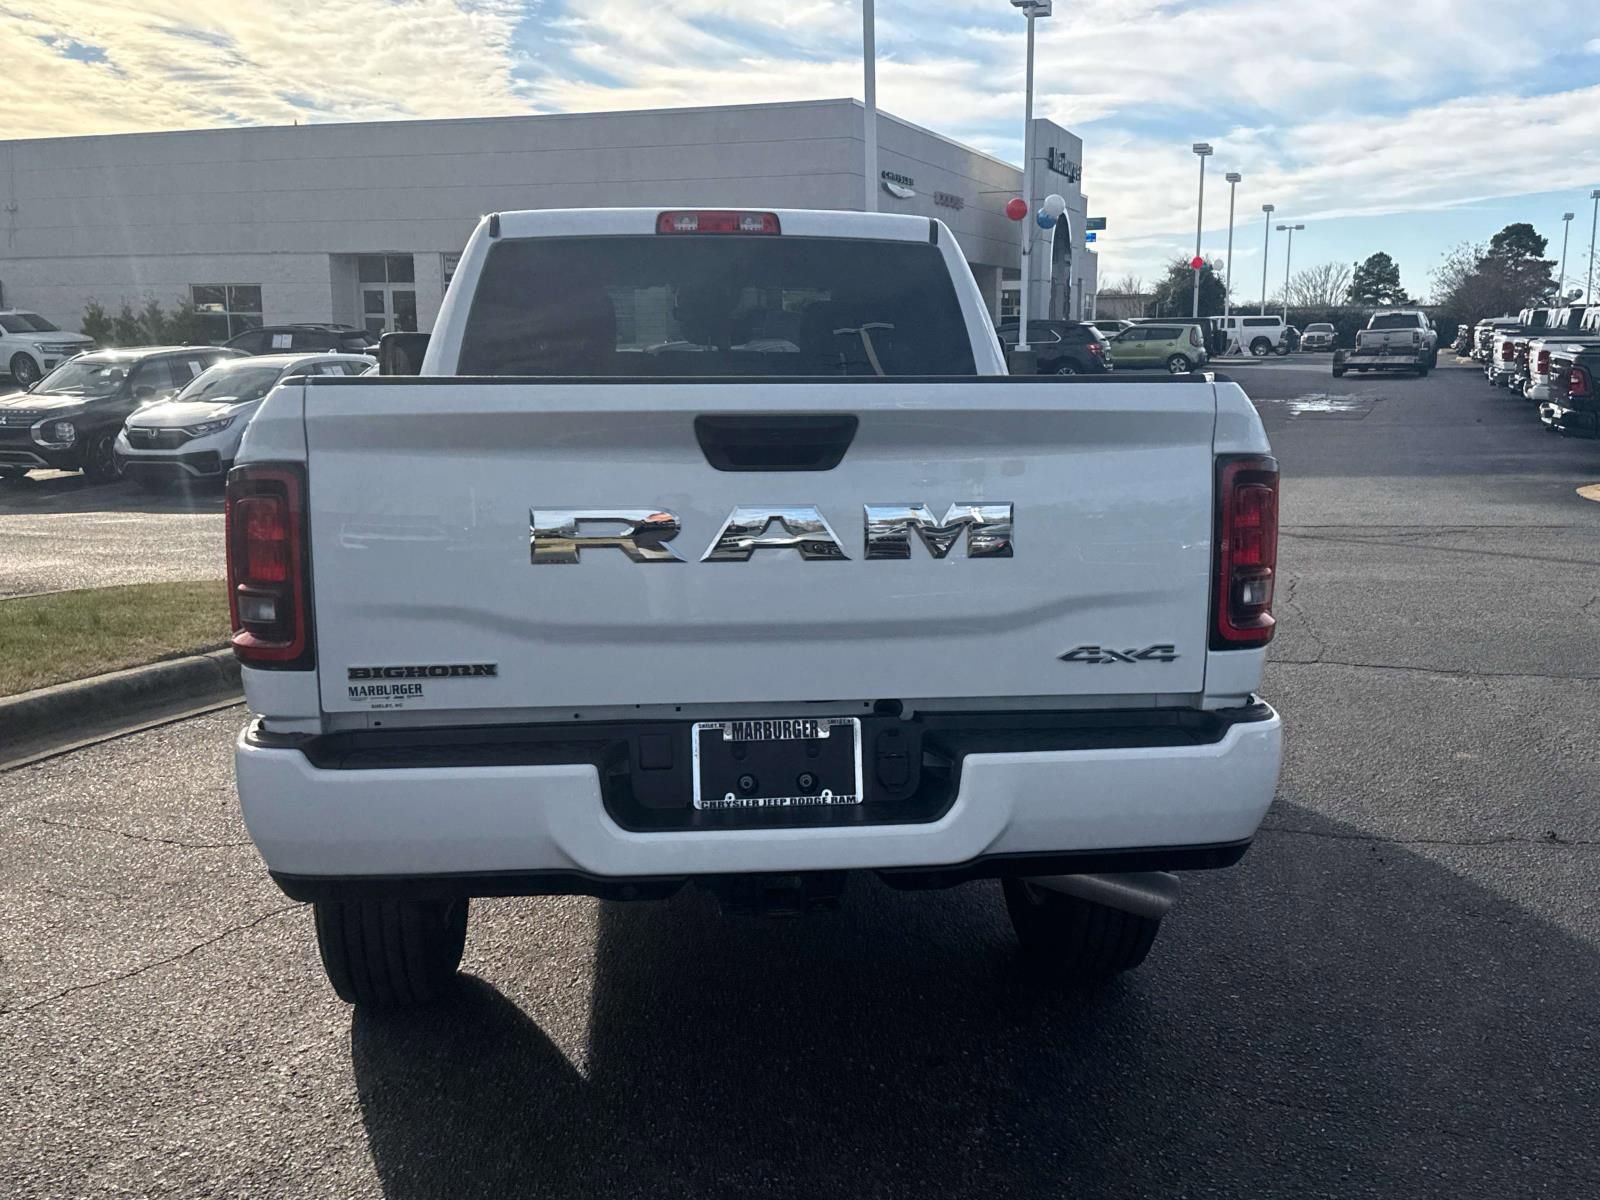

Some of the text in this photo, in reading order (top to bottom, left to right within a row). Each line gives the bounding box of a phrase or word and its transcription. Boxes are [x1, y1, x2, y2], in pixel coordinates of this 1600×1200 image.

[530, 501, 1014, 564] RAM
[348, 663, 497, 680] BIGHORN
[348, 683, 422, 697] MARBURGER
[732, 720, 819, 740] MARBURGER
[701, 795, 857, 809] CHRYSLER JEEP DODGE RAM
